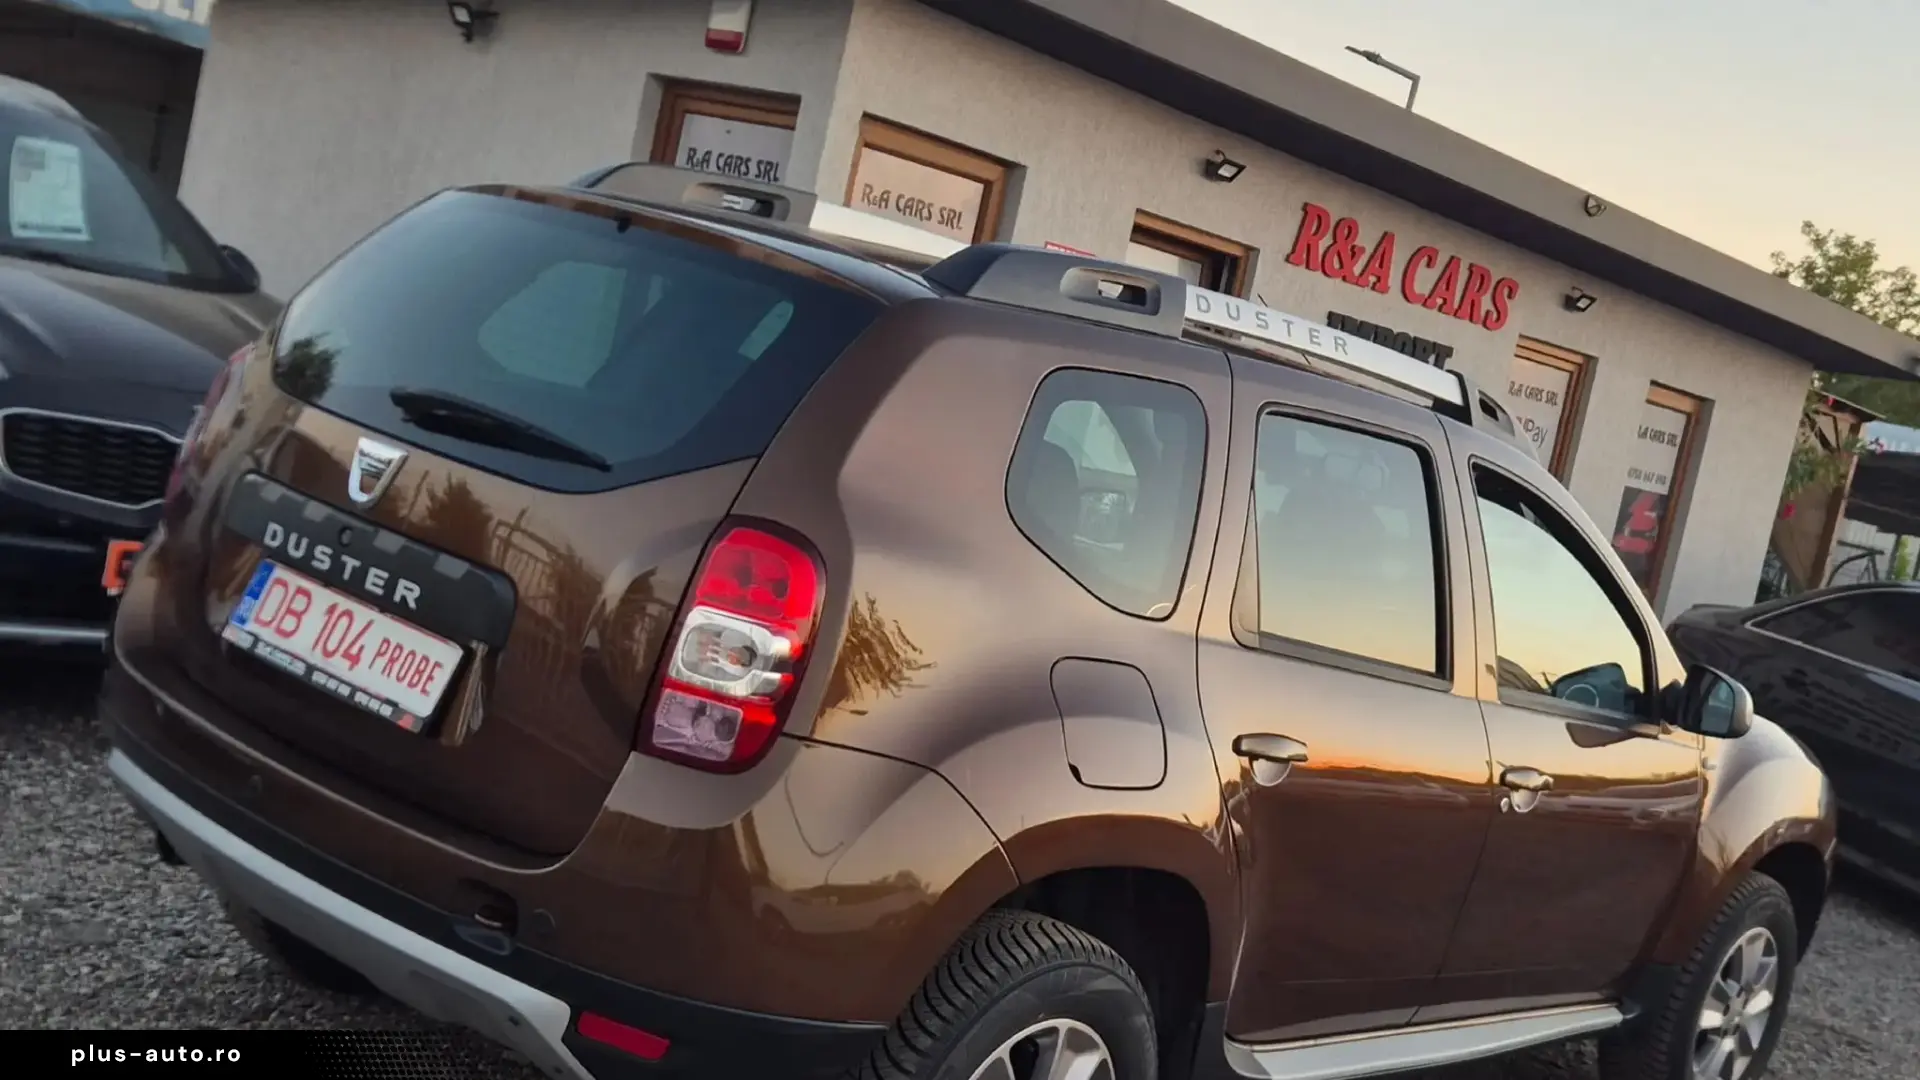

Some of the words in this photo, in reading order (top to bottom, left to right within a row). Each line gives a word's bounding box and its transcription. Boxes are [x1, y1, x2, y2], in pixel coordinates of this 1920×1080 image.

[716, 152, 752, 177] CARS
[755, 159, 780, 183] SRL
[861, 183, 891, 210] R&A
[896, 194, 934, 222] CARS
[938, 206, 963, 230] SRL
[1285, 202, 1395, 294] R&A
[1401, 246, 1519, 331] CARS
[1196, 293, 1348, 356] DUSTER
[1524, 385, 1544, 402] CARS
[1545, 390, 1559, 407] SRL
[263, 521, 421, 610] DUSTER
[254, 576, 312, 640] DB
[312, 602, 375, 672] 104
[368, 637, 443, 698] PROBE
